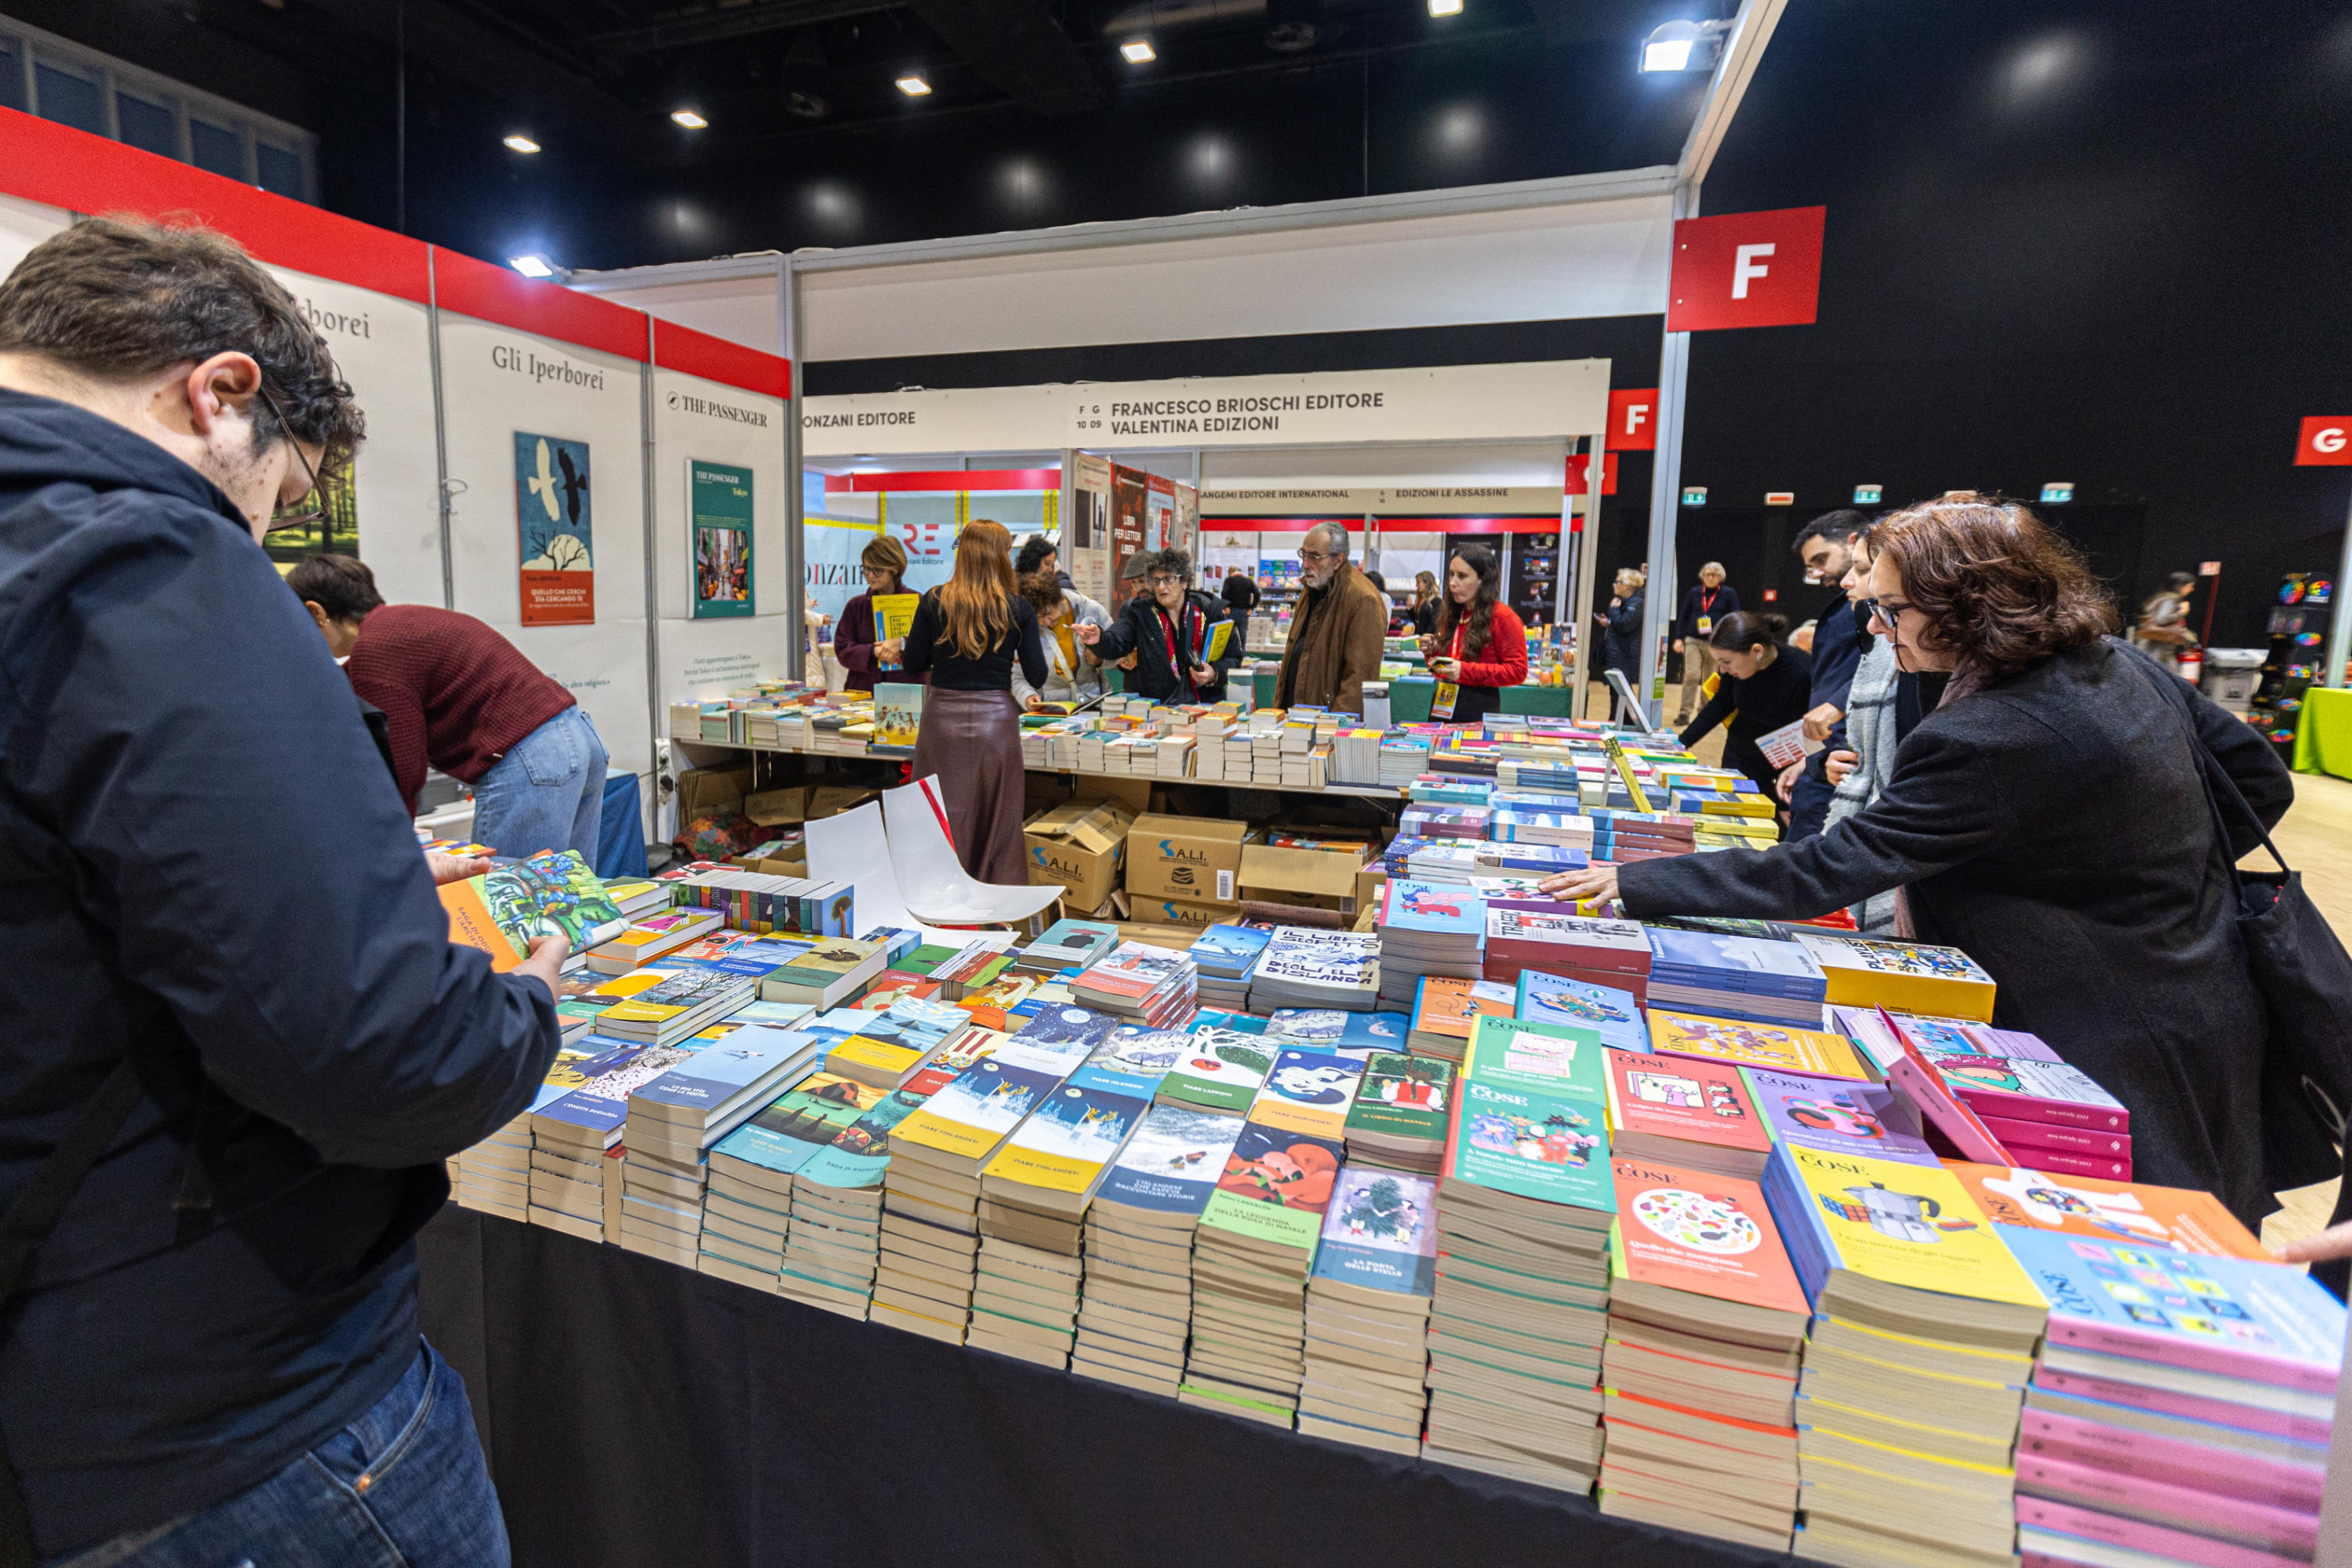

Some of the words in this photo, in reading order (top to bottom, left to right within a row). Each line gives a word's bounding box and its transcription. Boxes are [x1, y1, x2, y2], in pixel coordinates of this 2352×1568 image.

[1732, 243, 1775, 299] F
[299, 298, 371, 338] borei
[492, 345, 521, 373] Gli
[529, 354, 604, 390] Iperborei
[682, 395, 707, 415] THE
[708, 401, 767, 428] PASSENGER
[1080, 406, 1085, 414] F
[1093, 405, 1100, 413] G
[1112, 400, 1211, 416] FRANCESCO
[1217, 396, 1300, 413] BRIOSCHI
[1305, 393, 1384, 409] EDITORE
[803, 415, 853, 428] ONZANI
[858, 412, 916, 426] EDITORE
[1077, 420, 1086, 429] 10
[1090, 420, 1102, 429] 09
[1112, 419, 1198, 434] VALENTINA
[1204, 416, 1279, 432] EDIZIONI
[1626, 405, 1648, 434] F
[2312, 428, 2347, 452] G
[1239, 490, 1277, 499] EDITORE
[1279, 490, 1350, 499] INTERNATIONAL
[1396, 488, 1439, 498] EDIZIONI
[1441, 488, 1452, 498] LE
[1454, 488, 1509, 498] ASSASSINE
[458, 906, 472, 925] SAGA
[472, 926, 480, 935] DI
[1501, 910, 1524, 936] TRAFFIC
[1280, 936, 1379, 949] SEGRETO
[1312, 933, 1379, 943] LIBRO
[1269, 961, 1324, 973] DEGLI
[1331, 969, 1374, 978] ELFI
[1534, 974, 1576, 989] COSE
[1488, 1021, 1536, 1034] COSE
[1618, 1056, 1670, 1070] COSE
[1183, 1083, 1203, 1093] FIABE
[1757, 1075, 1815, 1092] COSE
[1470, 1086, 1528, 1106] COSE
[920, 1124, 937, 1132] FIABE
[939, 1129, 979, 1144] FINLANDESI
[1014, 1158, 1034, 1168] FIABE
[1035, 1163, 1080, 1176] FINLANDESI
[1800, 1155, 1870, 1176] COSE
[1617, 1168, 1679, 1185] COSE
[1276, 1223, 1307, 1234] NATALE
[1629, 1240, 1664, 1252] Quello
[1665, 1246, 1684, 1256] che
[1686, 1251, 1743, 1268] mangiamo
[1344, 1262, 1371, 1272] DELLE
[1372, 1266, 1403, 1277] STELLE
[1367, 1261, 1396, 1271] PORTA
[2041, 1269, 2093, 1315] COSE
